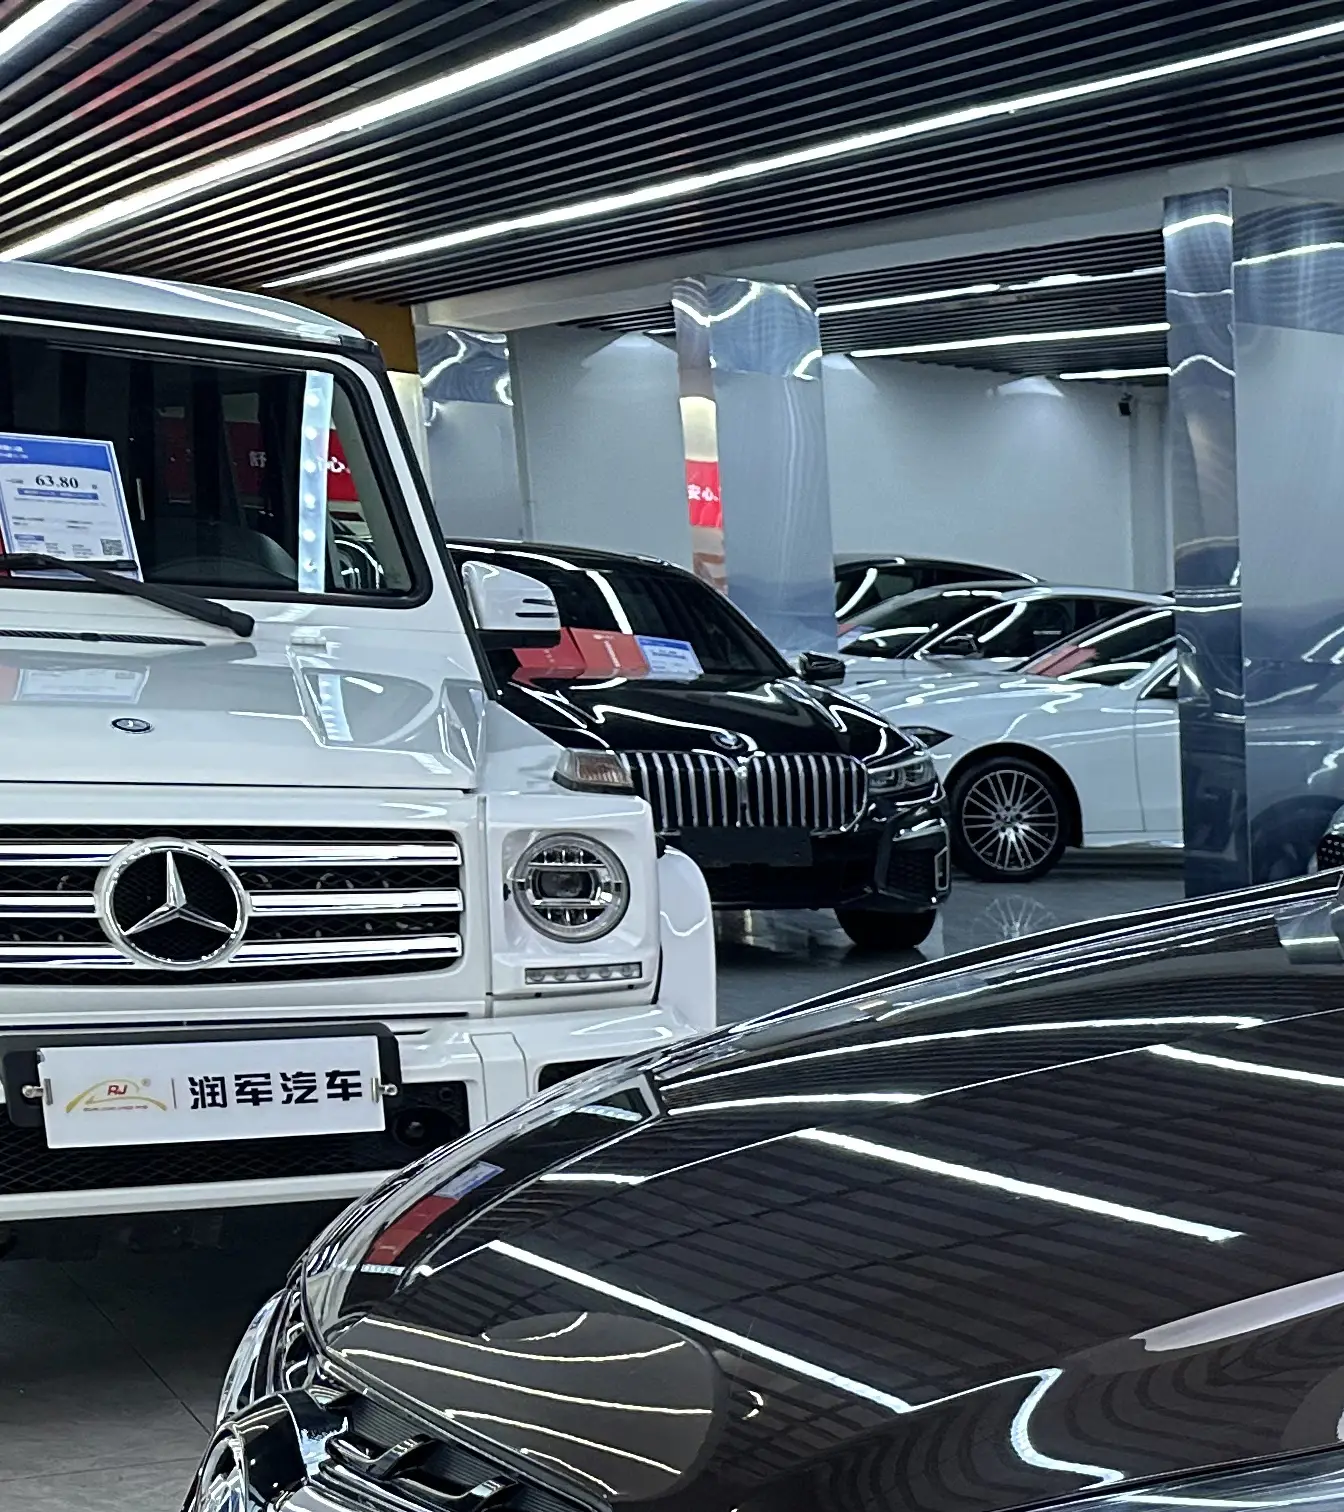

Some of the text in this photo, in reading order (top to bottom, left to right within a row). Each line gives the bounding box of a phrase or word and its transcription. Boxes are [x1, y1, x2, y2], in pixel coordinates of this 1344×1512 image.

[35, 474, 79, 489] 63.80
[187, 1069, 363, 1110] 润军汽车
